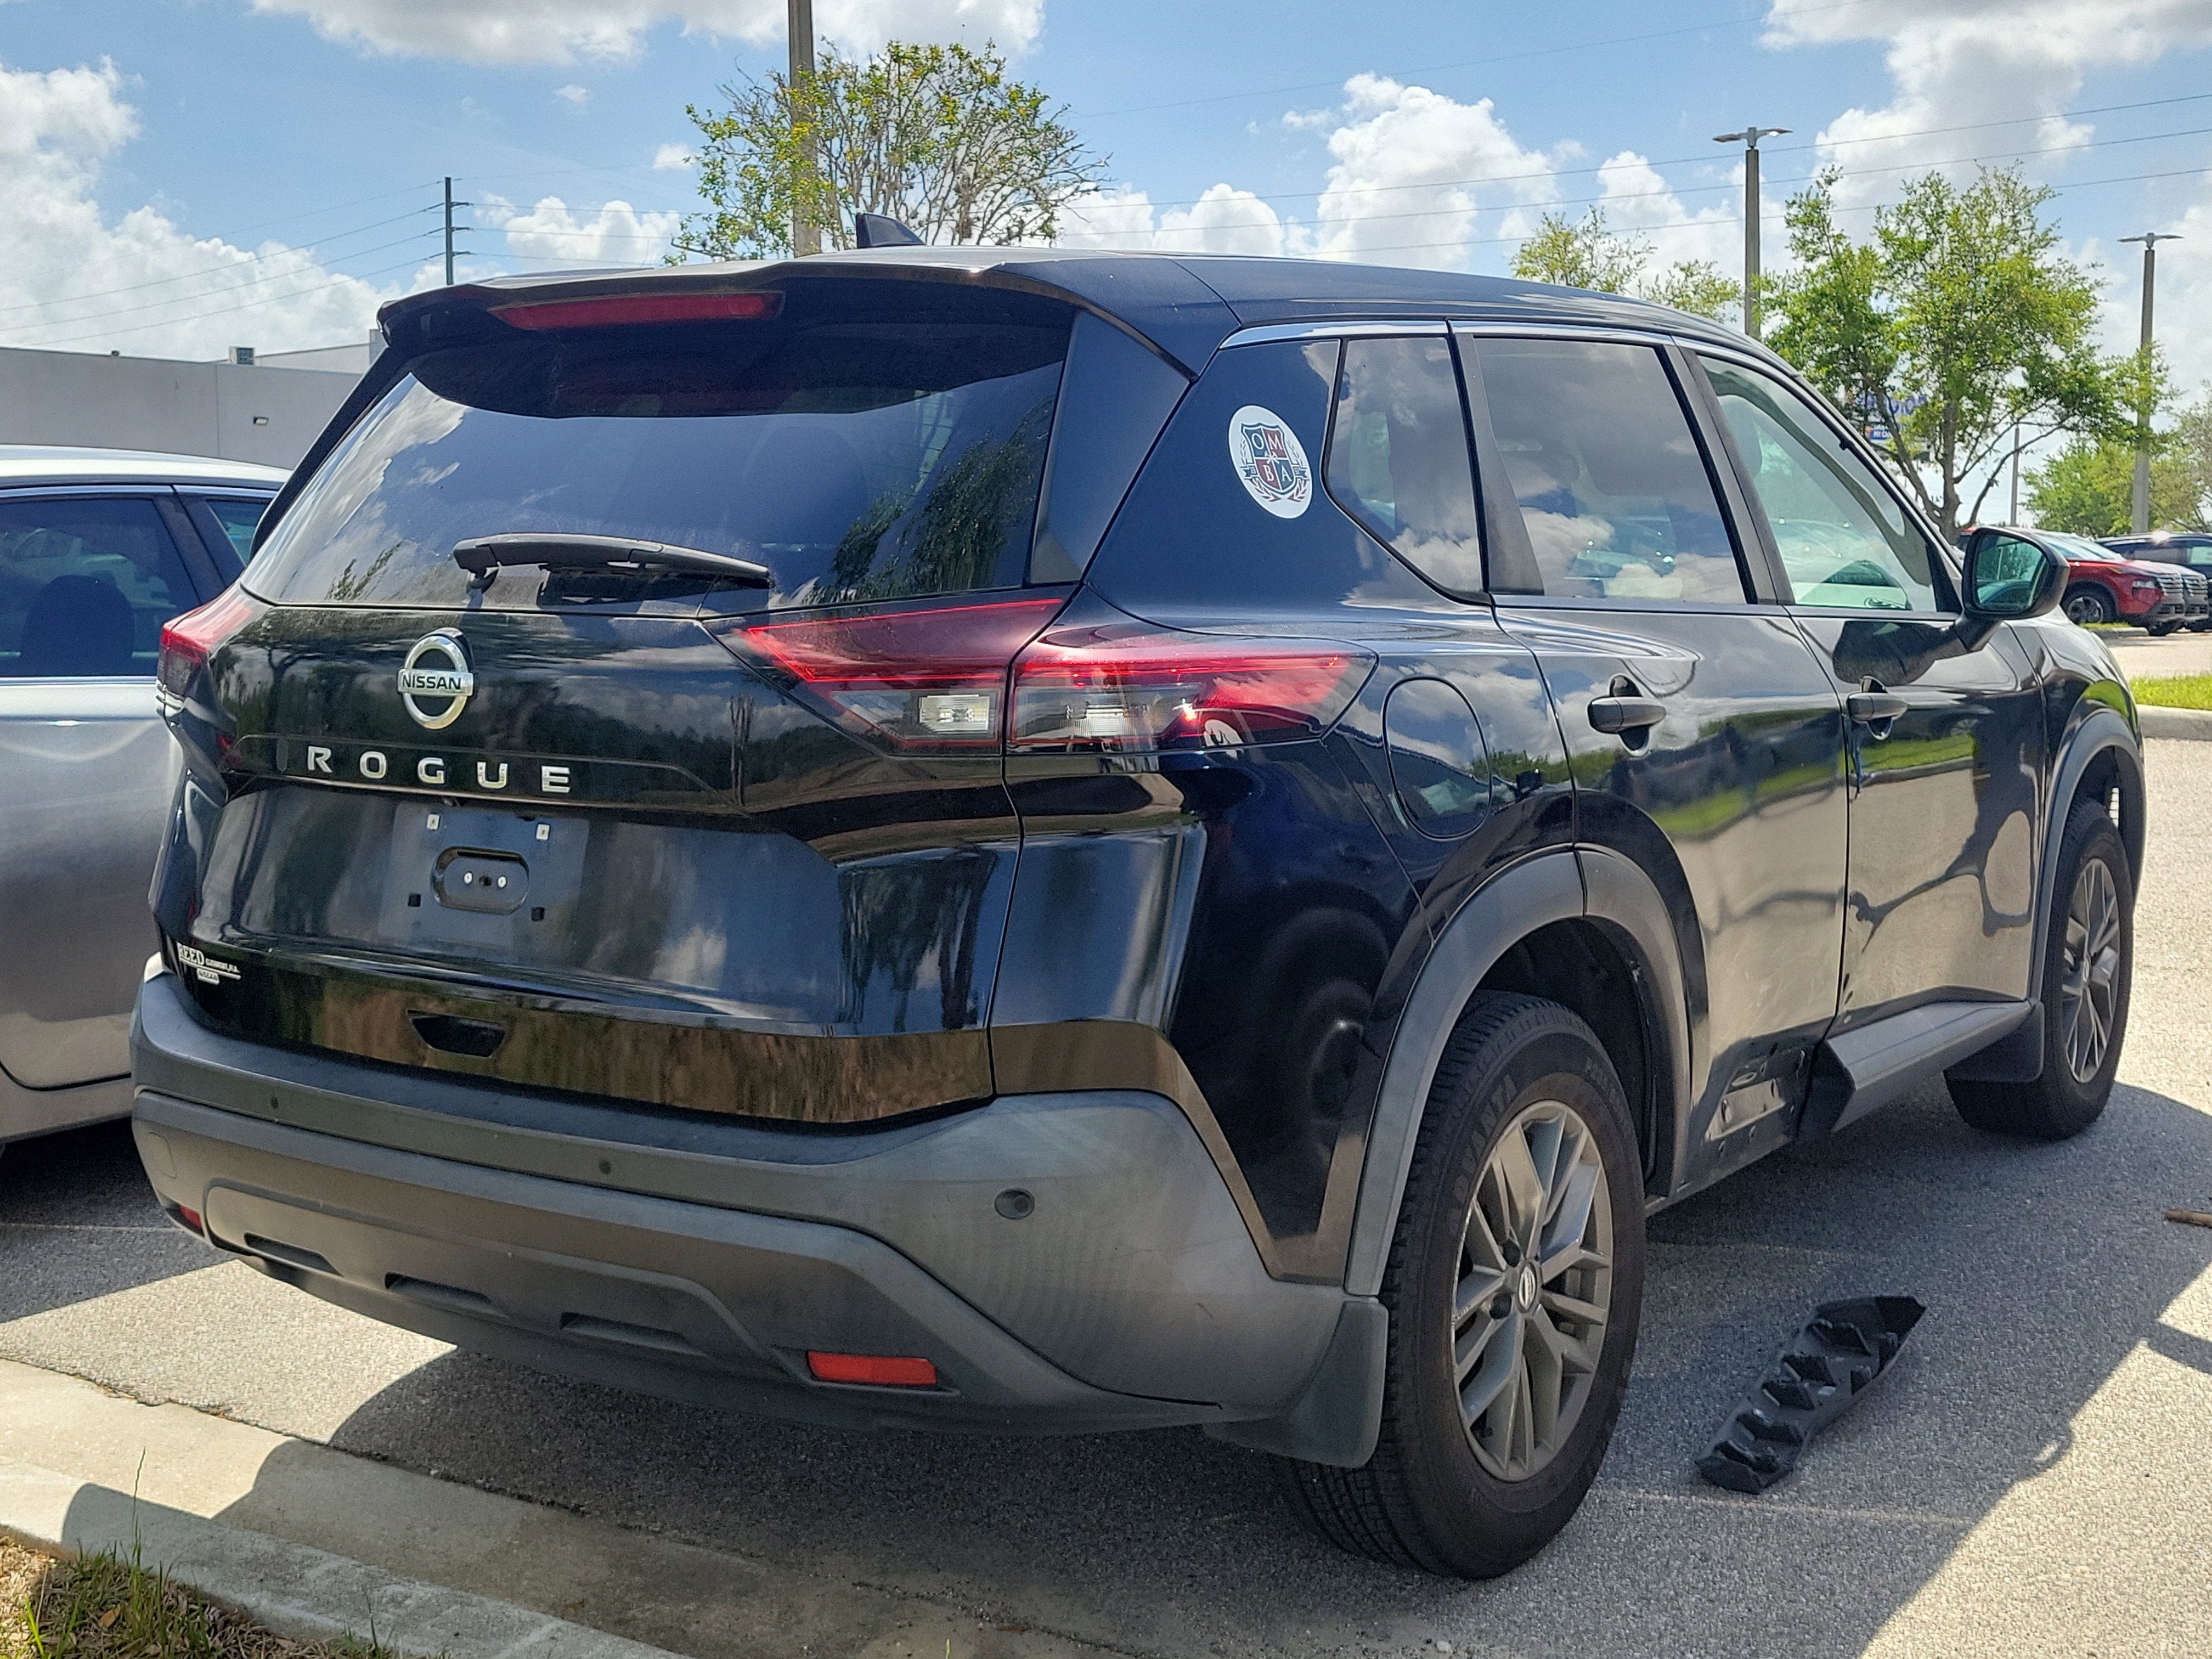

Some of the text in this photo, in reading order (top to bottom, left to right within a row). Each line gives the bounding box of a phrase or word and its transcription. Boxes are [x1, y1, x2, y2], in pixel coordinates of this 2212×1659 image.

[402, 674, 461, 690] NISSAN
[307, 745, 571, 793] ROGUE
[1447, 1074, 1517, 1240] ADVANTA
